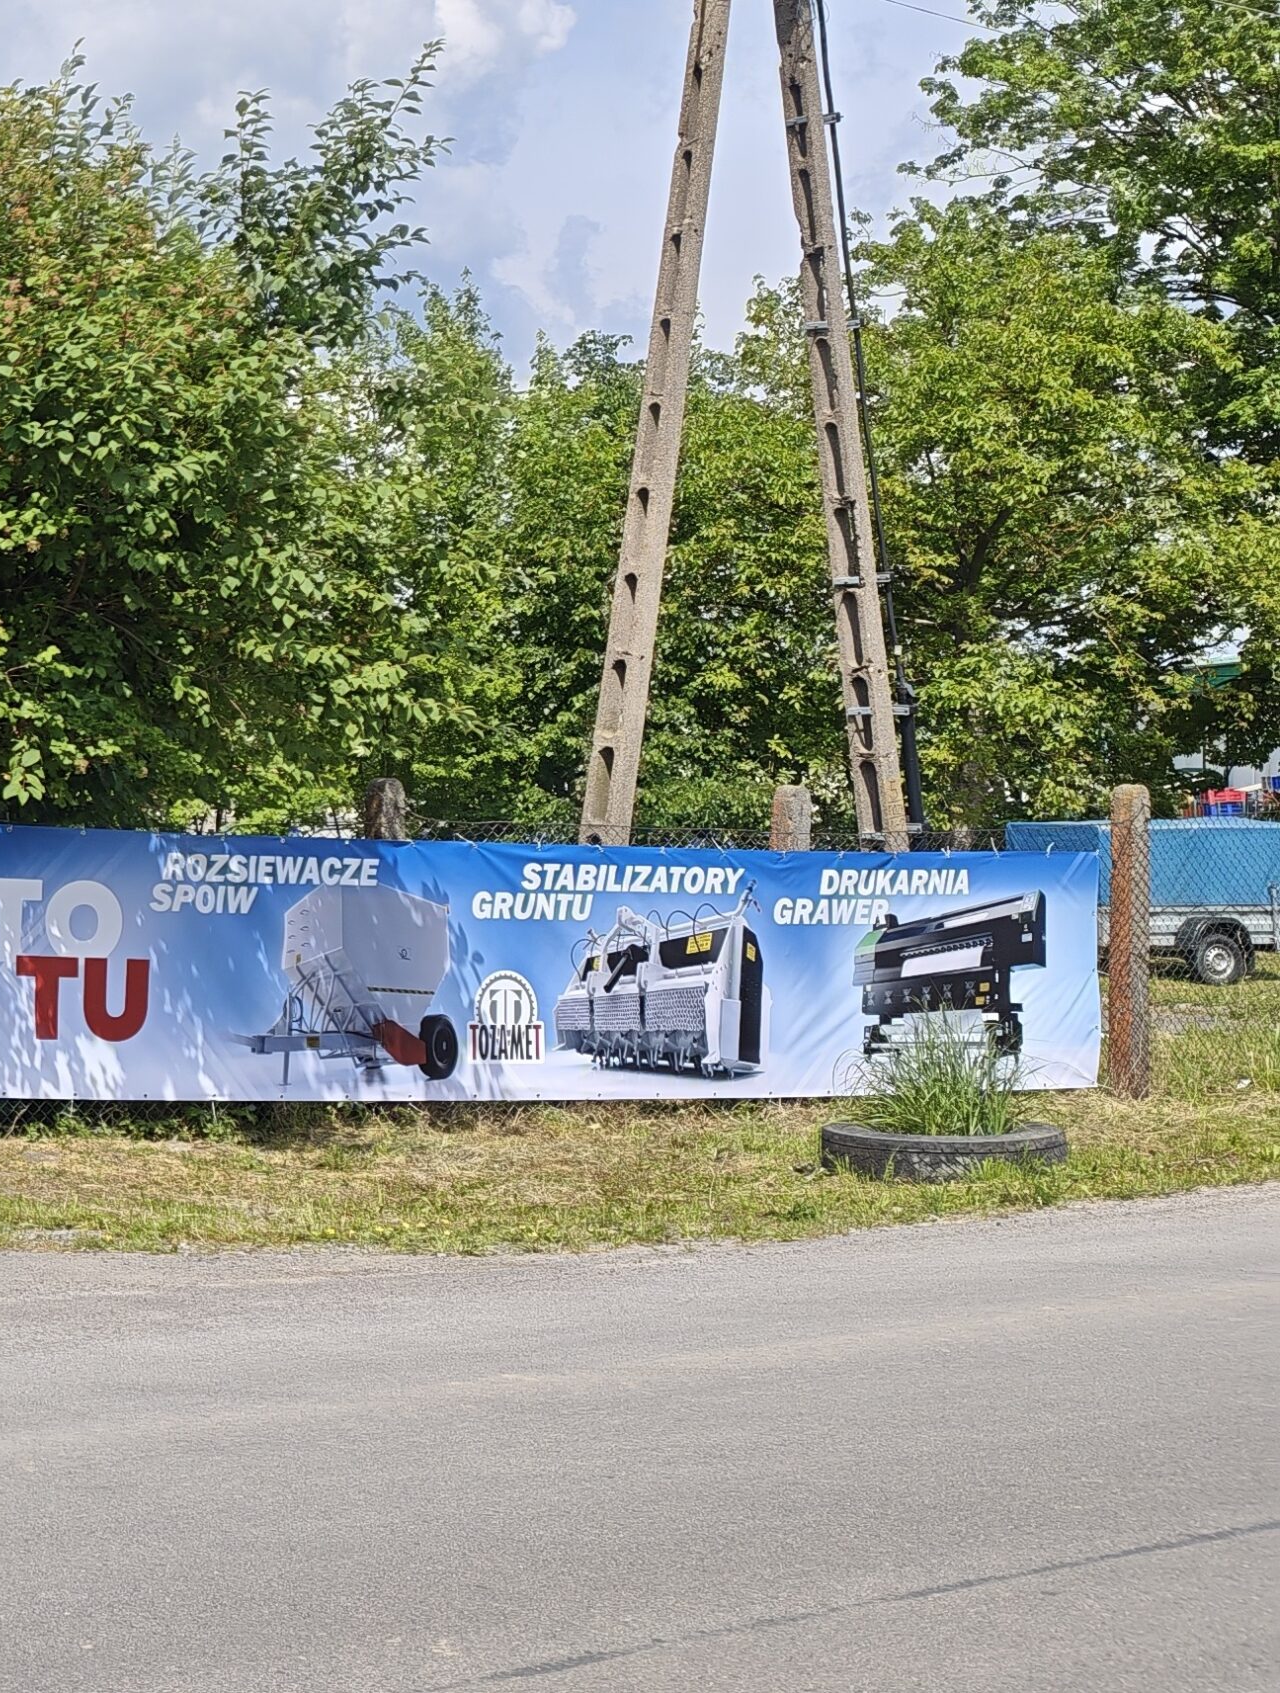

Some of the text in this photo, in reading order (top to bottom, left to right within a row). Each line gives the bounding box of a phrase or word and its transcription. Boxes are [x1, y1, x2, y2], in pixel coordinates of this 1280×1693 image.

[162, 852, 380, 887] ROZSIEWACZE
[521, 863, 745, 895] STABILIZATORY
[819, 869, 969, 896] DRUKARNIA
[149, 883, 259, 915] SPOIW
[472, 891, 593, 921] GRUNTU
[773, 897, 889, 926] GRAWER
[16, 955, 151, 1043] TU
[469, 1024, 542, 1061] TOZAMET
